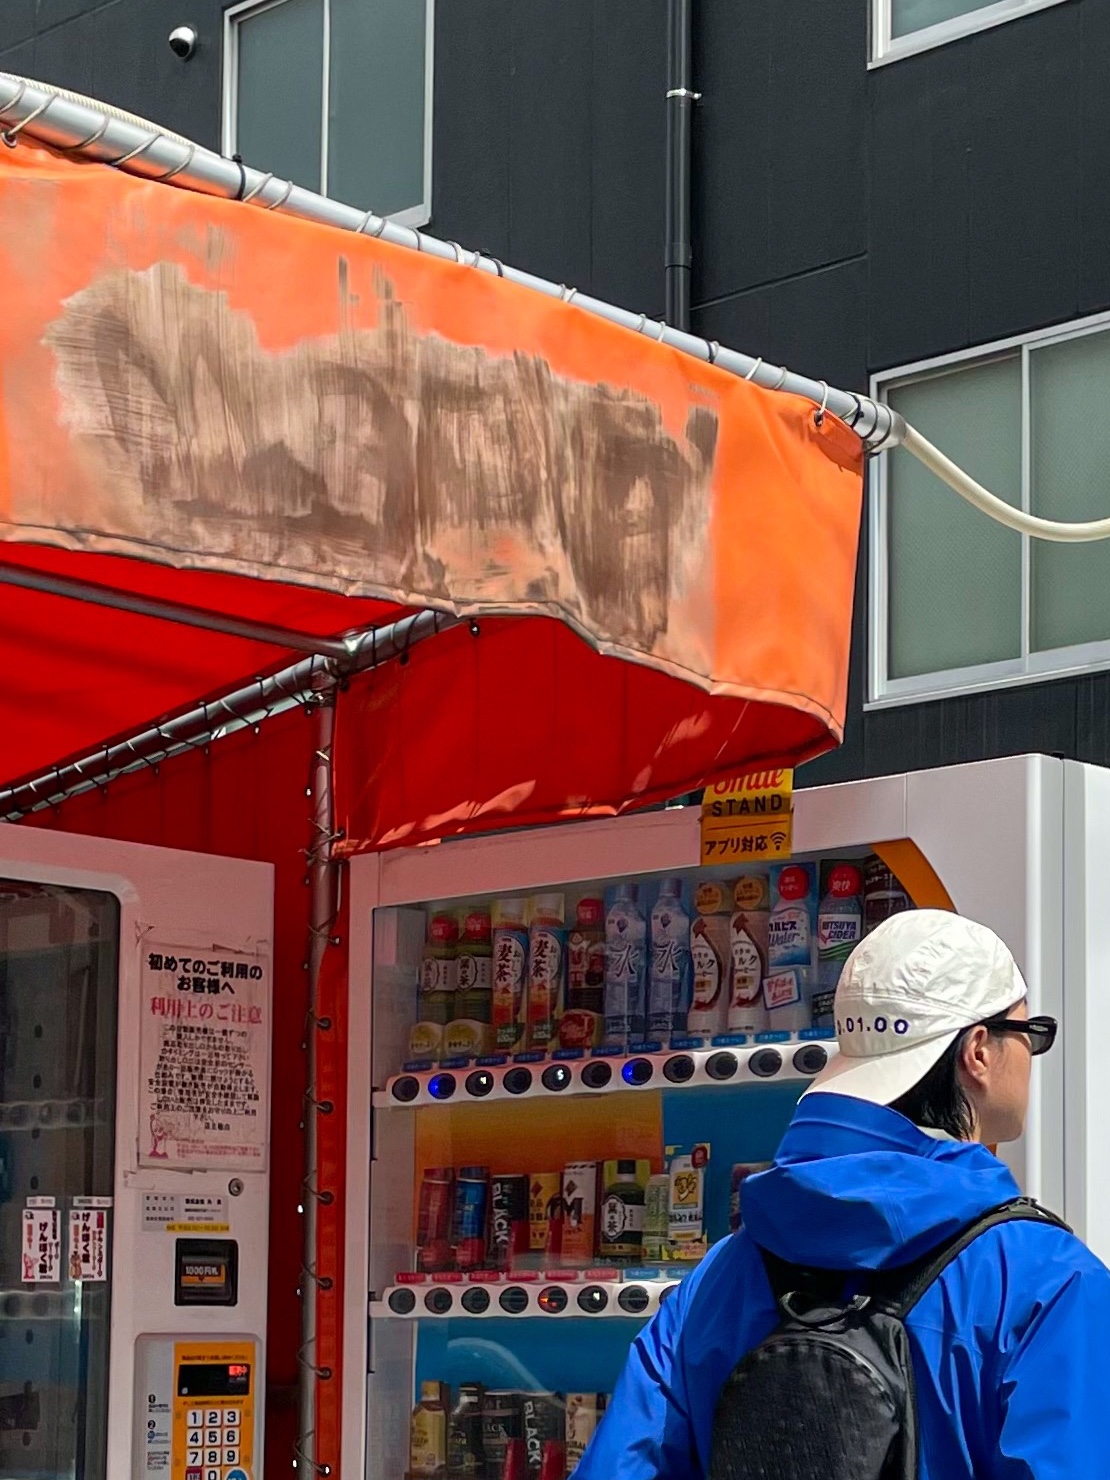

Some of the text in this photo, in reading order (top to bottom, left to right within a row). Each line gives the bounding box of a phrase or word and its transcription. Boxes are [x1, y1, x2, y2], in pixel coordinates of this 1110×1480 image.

[712, 794, 783, 817] STAND
[705, 835, 768, 855] アプリ対応
[829, 930, 855, 940] CIDER
[148, 953, 263, 980] 初めてのご利用の
[177, 975, 235, 995] お客様へ
[151, 997, 262, 1024] 利用上のご注意
[208, 1412, 218, 1423] 2
[227, 1411, 237, 1422] 3
[190, 1431, 236, 1443] 4 5 6
[523, 1400, 543, 1466] BLACK
[190, 1450, 236, 1463] 7 8 9
